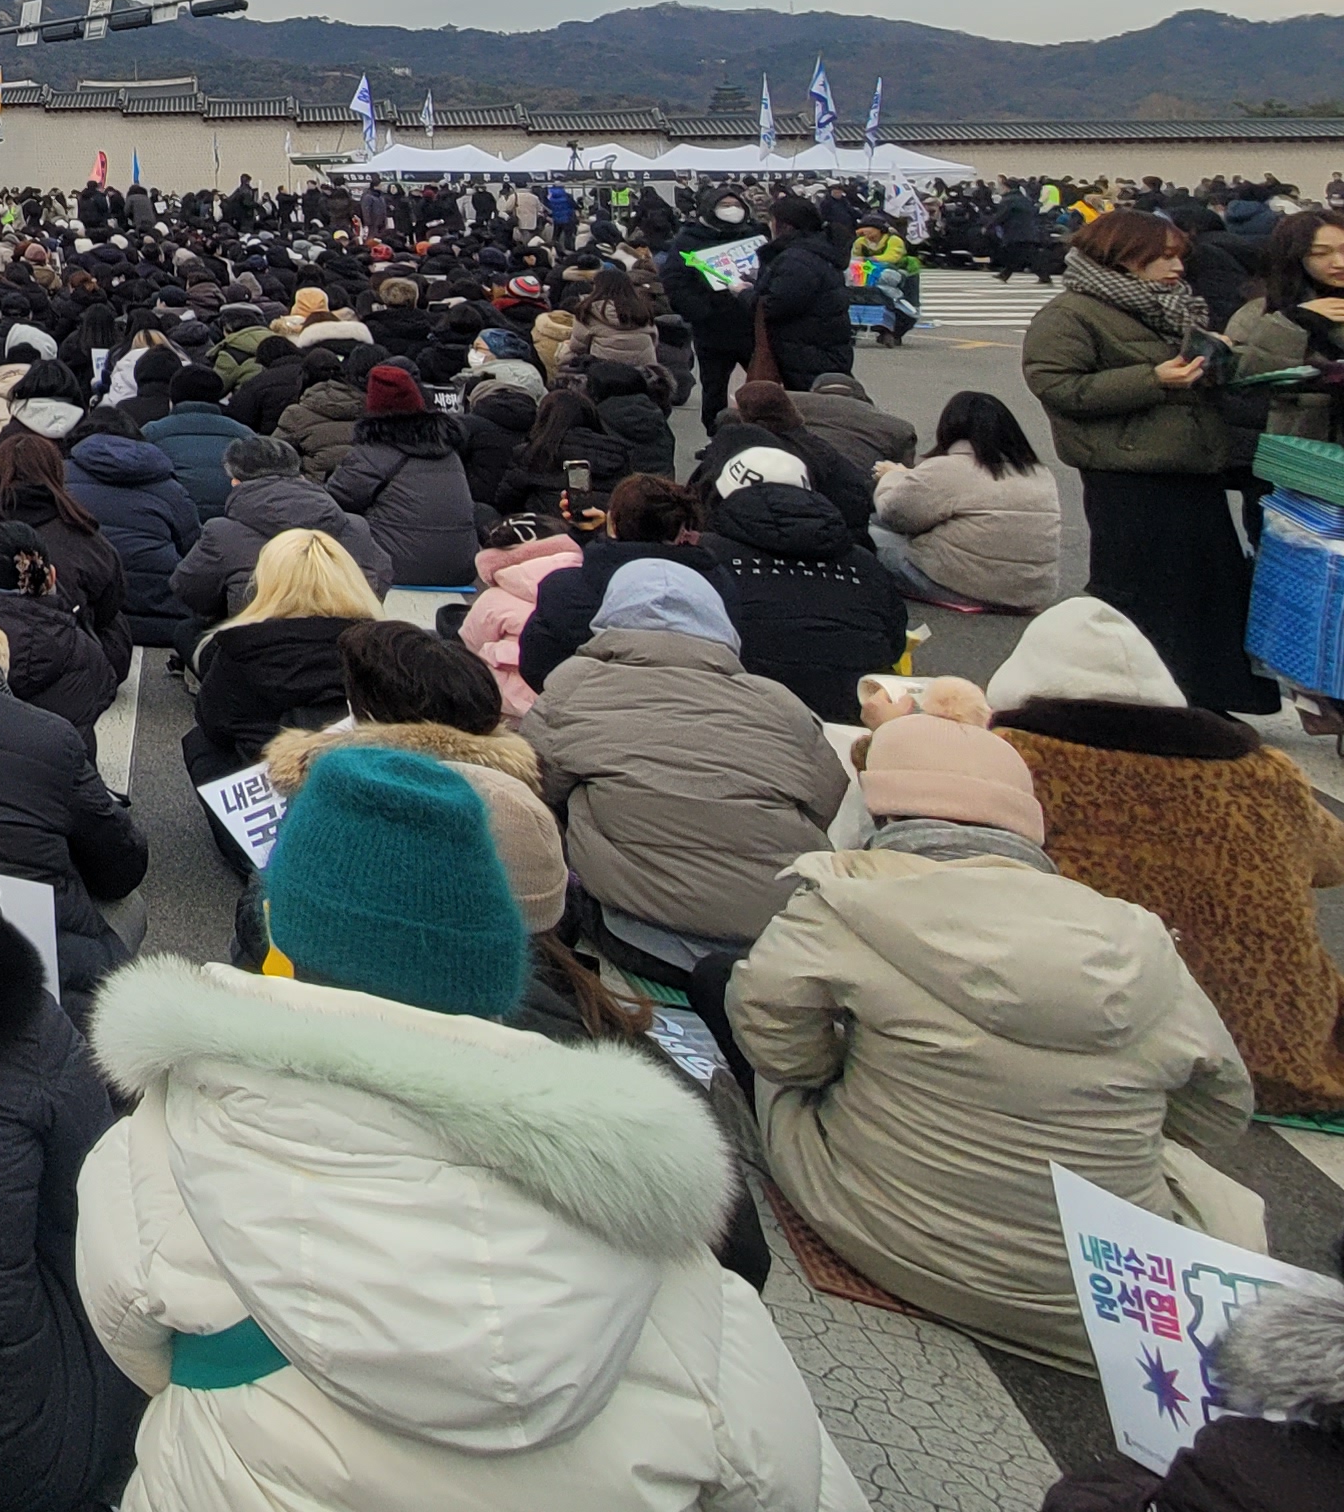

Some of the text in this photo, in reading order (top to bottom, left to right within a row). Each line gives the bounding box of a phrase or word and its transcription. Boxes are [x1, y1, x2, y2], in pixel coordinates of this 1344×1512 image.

[731, 557, 858, 574] DYNAFIT
[734, 568, 861, 586] TRAINING
[1078, 1231, 1176, 1292] 내란수괴
[1088, 1273, 1184, 1343] 윤석열
